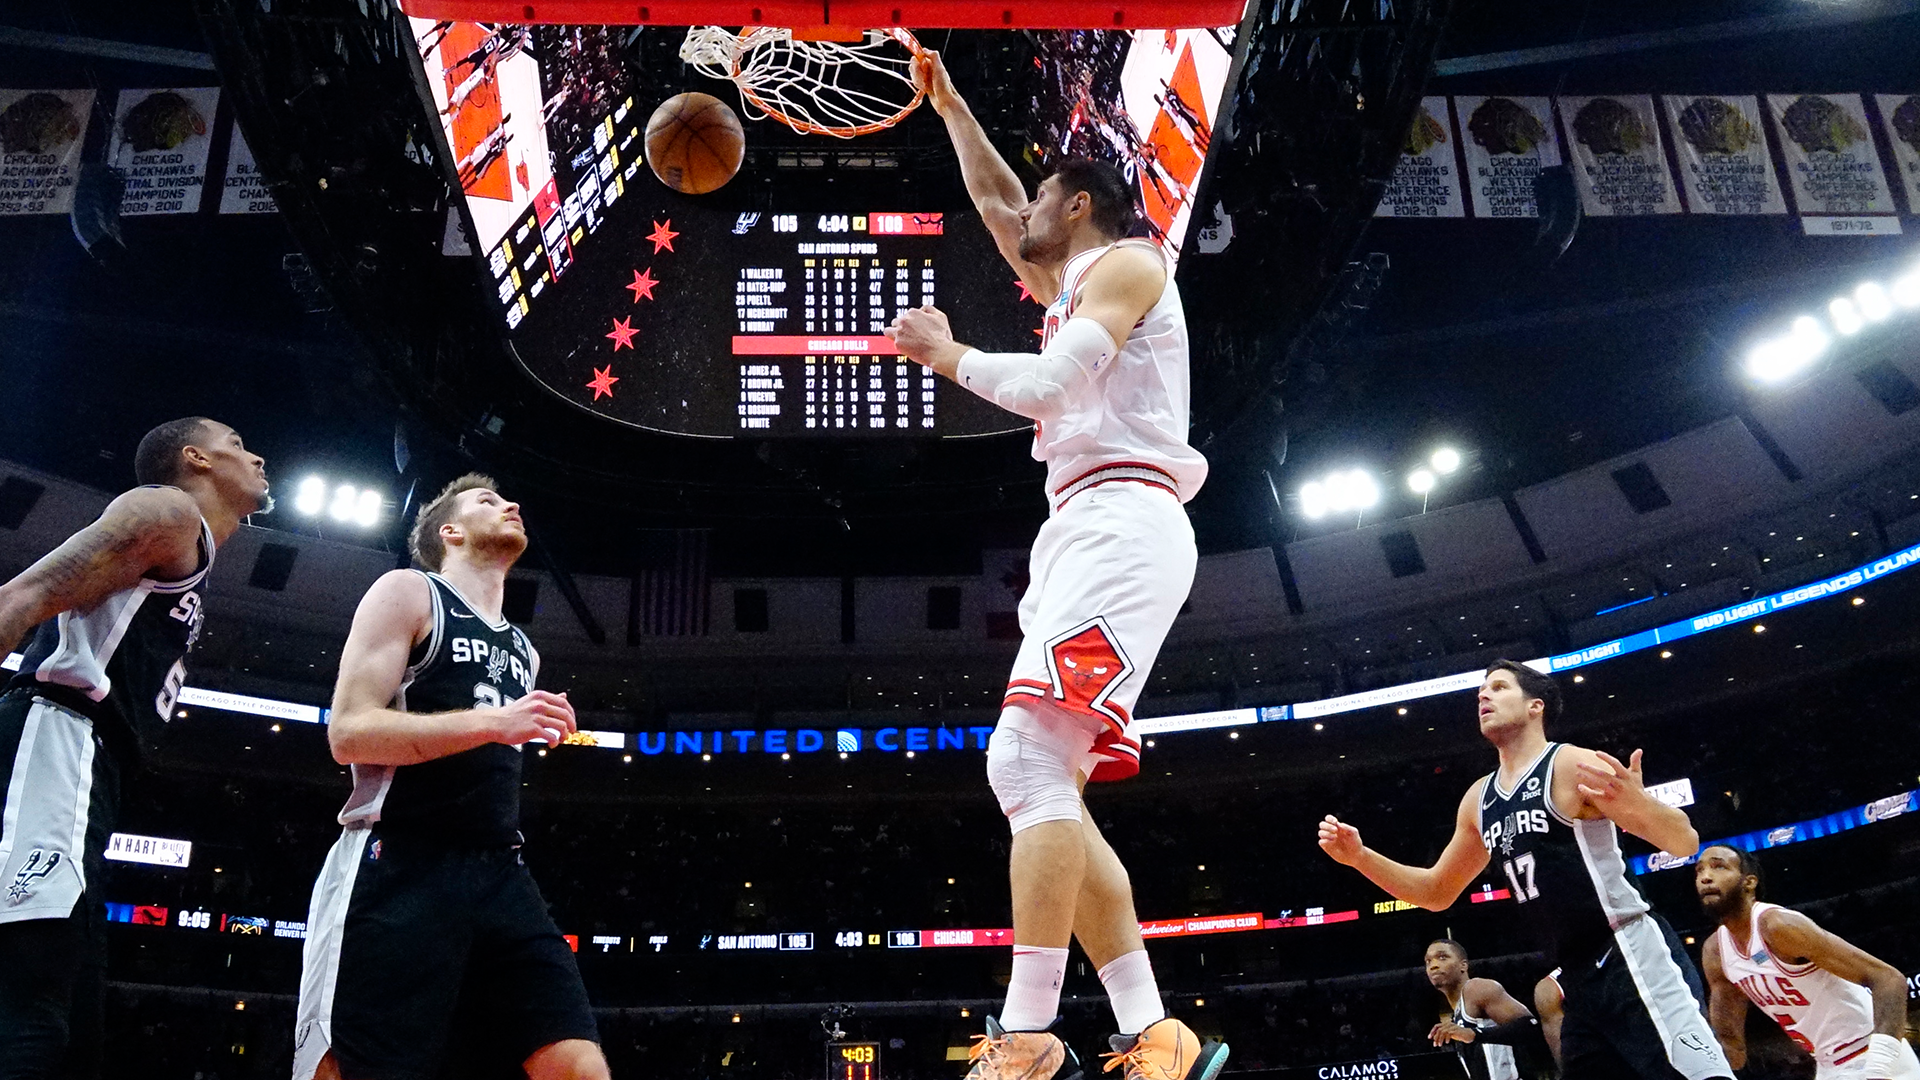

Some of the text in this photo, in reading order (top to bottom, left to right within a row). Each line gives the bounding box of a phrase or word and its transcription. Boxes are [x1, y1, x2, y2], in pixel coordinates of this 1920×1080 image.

[3, 154, 56, 165] CHICAGO
[132, 154, 183, 165] CHICAGO
[1490, 157, 1538, 167] CHICAGO
[2, 165, 68, 176] ACKHAWKS
[1392, 166, 1449, 176] CKHAWKS
[157, 176, 203, 188] DIVISION
[125, 189, 186, 200] HAMPIONS
[1384, 186, 1450, 196] ONFERENCE
[1393, 206, 1438, 216] 2012-13
[1491, 206, 1537, 216] 2009-2
[772, 215, 798, 232] 105
[818, 215, 849, 232] 4:04
[798, 243, 877, 254] SAN ANTONIO SPURS
[746, 269, 774, 279] WALKER
[806, 269, 814, 279] 21
[806, 282, 813, 292] 11
[869, 282, 881, 292] 4/7
[746, 295, 772, 305] POELTL
[822, 295, 827, 305] 2
[851, 295, 856, 305] 7
[737, 308, 745, 318] 17
[851, 308, 856, 318] 4
[808, 340, 868, 350] CHICAGO BULLS
[837, 366, 842, 375] 4
[851, 365, 856, 375] 7
[870, 365, 881, 376] 2/7
[741, 379, 746, 389] 7
[747, 378, 772, 389] BROWN
[806, 378, 815, 389] 27
[822, 378, 827, 389] 2
[747, 391, 776, 402] VUCEVIC
[822, 392, 828, 402] 2
[835, 391, 843, 402] 21
[867, 391, 886, 402] 10/22
[898, 391, 908, 402] 1/7
[738, 405, 746, 415] 12
[822, 405, 828, 414] 4
[835, 405, 843, 415] 12
[898, 404, 908, 415] 1/4
[923, 404, 934, 415] 1/2
[747, 417, 770, 428] WHITE
[822, 418, 828, 428] 4
[851, 418, 857, 427] 4
[922, 417, 934, 427] 4/4
[1693, 614, 1723, 631] BUD
[1724, 601, 1767, 625] LIGHT
[1771, 571, 1863, 609] LEGENDS
[1552, 643, 1621, 669] BUD LIGHT
[1430, 679, 1468, 690] POPCORN
[638, 729, 824, 755] UNITED
[1521, 790, 1541, 801] Frost
[125, 838, 158, 855] HART
[1503, 851, 1540, 905] 17
[1374, 901, 1394, 914] FAST
[178, 910, 210, 928] 9:05
[1187, 917, 1257, 931] CHAMPIONS CLUB
[275, 920, 305, 930] ORLANDO
[274, 929, 300, 938] DENVER
[718, 935, 737, 949] SAN
[738, 934, 777, 949] ANTONIO
[788, 935, 806, 948] 105
[835, 932, 863, 947] 4:03
[933, 931, 973, 945] CHICAGO
[842, 1047, 873, 1062] 4:03
[1318, 1060, 1398, 1079] CALAMOS
